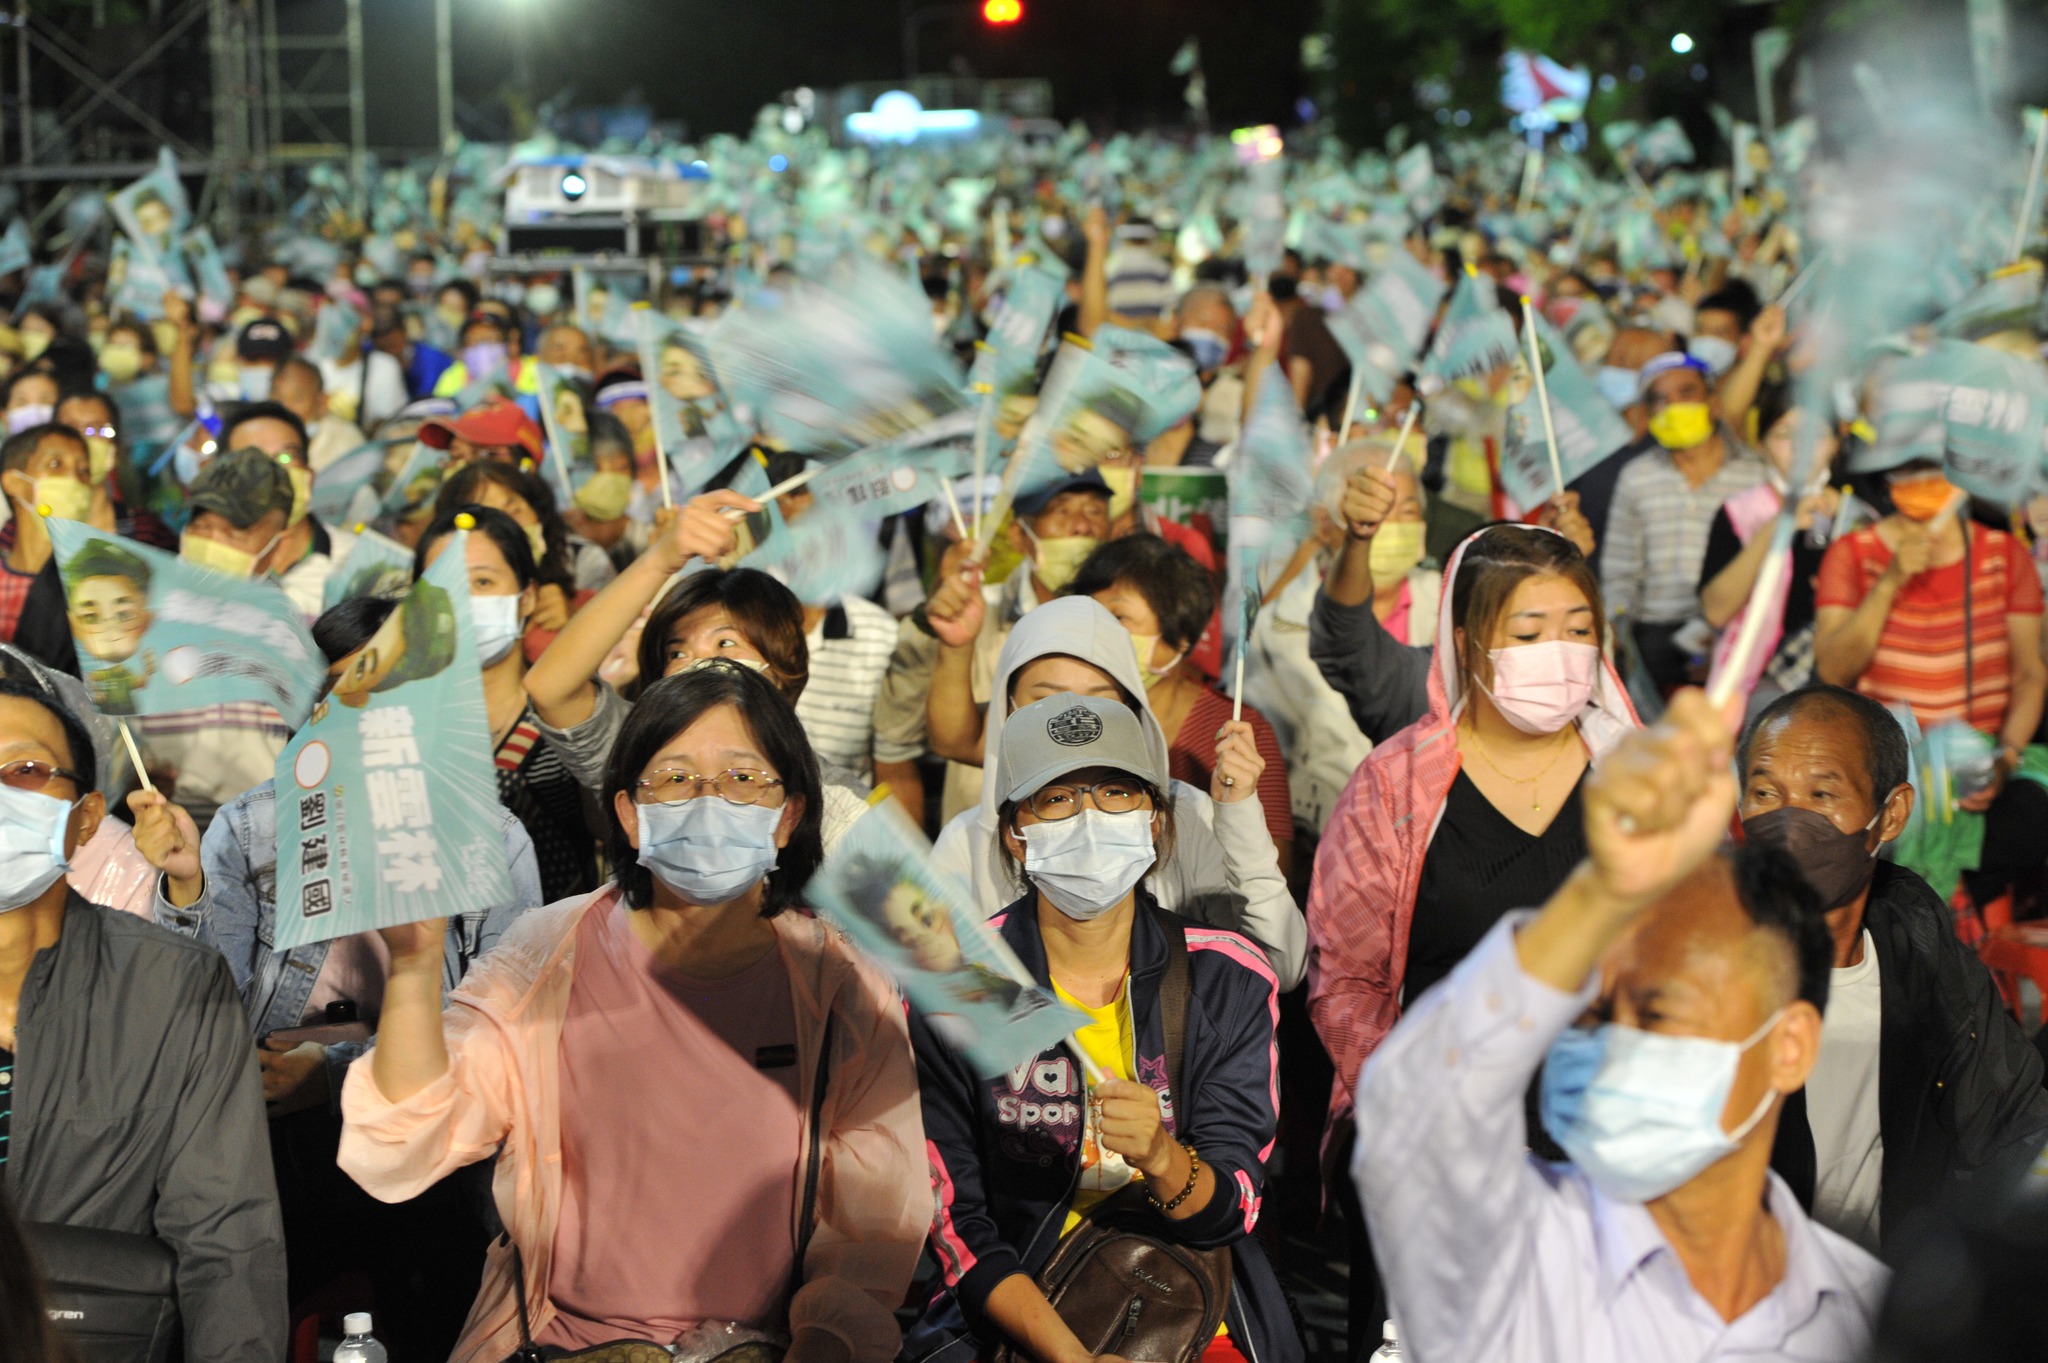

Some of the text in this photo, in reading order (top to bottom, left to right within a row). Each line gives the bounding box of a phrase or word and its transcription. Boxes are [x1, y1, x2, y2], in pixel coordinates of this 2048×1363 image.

[300, 792, 332, 917] 劉建國
[359, 705, 442, 892] 新雲林
